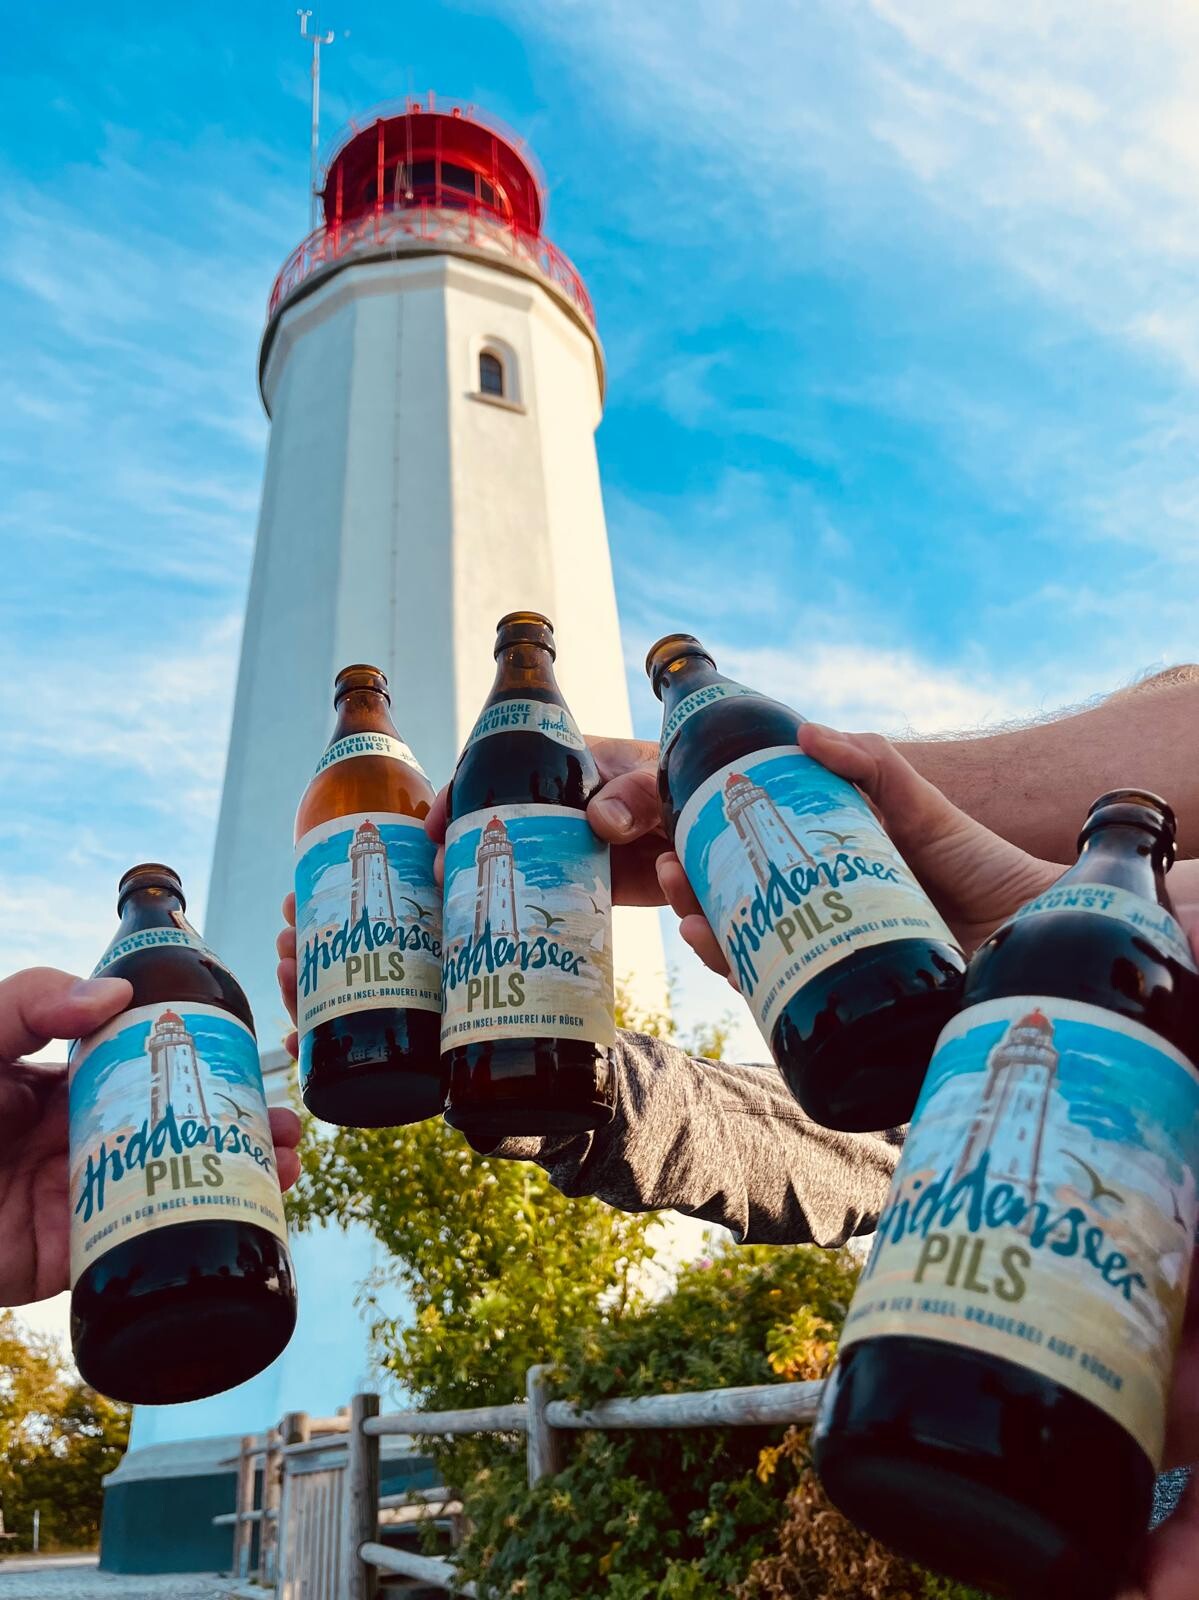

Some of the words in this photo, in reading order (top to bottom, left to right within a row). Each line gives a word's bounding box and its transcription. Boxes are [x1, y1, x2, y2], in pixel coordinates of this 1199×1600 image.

[727, 852, 900, 998] Hiddenseer
[774, 890, 853, 956] PILS
[298, 904, 442, 998] Hiddensee
[345, 951, 406, 988] PILS
[784, 961, 801, 982] DER
[881, 917, 900, 930] AUF
[328, 996, 337, 1008] IN
[337, 993, 352, 1004] DER
[353, 987, 418, 1001] INSEL-BRAUEREI
[419, 989, 433, 1000] AUF
[467, 972, 526, 1013] PILS
[451, 1024, 459, 1034] IN
[458, 1021, 472, 1032] DER
[472, 1014, 539, 1030] INSEL-BRAUEREI
[540, 1014, 557, 1025] AUF
[559, 1013, 585, 1027] RÜGEN
[75, 1102, 273, 1224] Hiddenseer
[145, 1153, 225, 1197] PILS
[121, 1213, 133, 1227] IN
[134, 1204, 155, 1220] DER
[912, 1231, 1032, 1303] PILS
[1046, 1335, 1078, 1360] AUF
